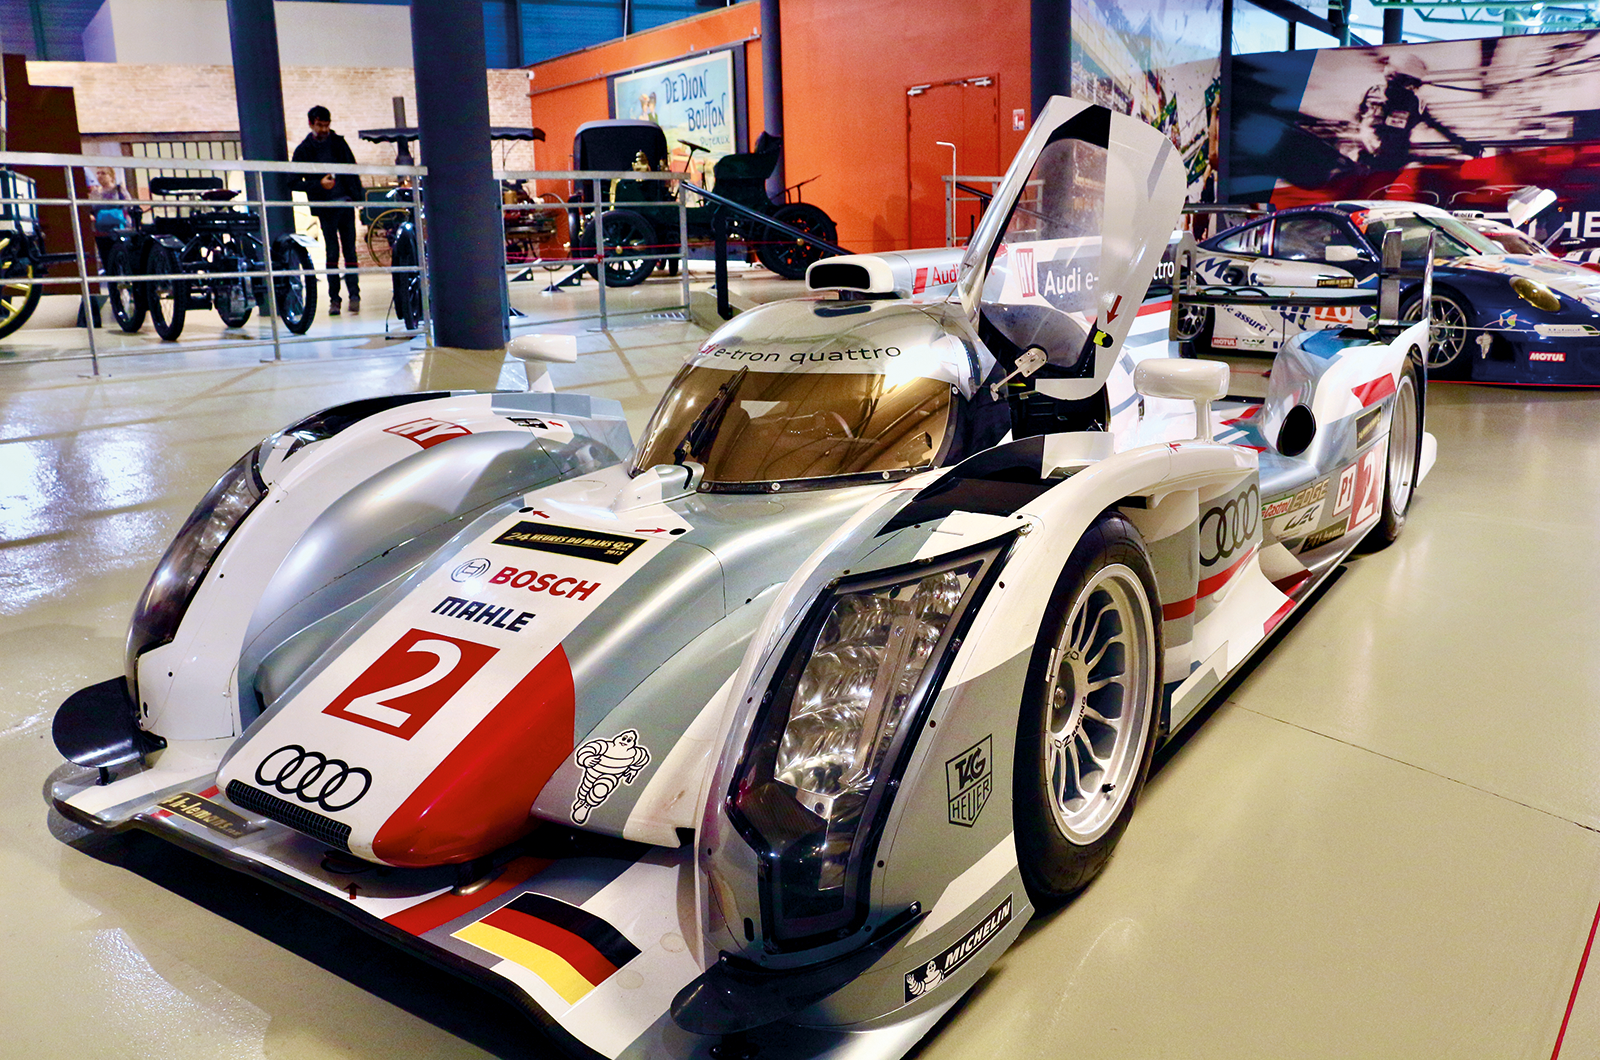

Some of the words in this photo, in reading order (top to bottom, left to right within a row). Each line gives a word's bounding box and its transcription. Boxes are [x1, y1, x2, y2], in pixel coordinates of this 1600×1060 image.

[661, 77, 679, 104] DE
[678, 69, 708, 101] DION
[685, 92, 726, 134] BOUTON
[931, 264, 959, 287] Audi
[1017, 248, 1036, 297] HY
[1044, 267, 1082, 297] Audi
[714, 347, 780, 362] e-tron
[789, 346, 901, 364] quattro
[1529, 352, 1565, 362] MOTUL
[1264, 499, 1292, 518] Castrol
[1292, 478, 1330, 507] EDGE
[1338, 472, 1354, 508] P1
[1355, 450, 1376, 525] 2
[1283, 504, 1321, 531] WEC
[504, 532, 531, 542] 24
[530, 533, 566, 543] HEURES
[565, 536, 582, 546] DU
[580, 539, 614, 549] MANS
[489, 566, 601, 601] BOSCH
[431, 596, 536, 633] MAHLE
[343, 639, 462, 728] 2
[1072, 696, 1087, 737] RACING
[955, 747, 986, 791] TAG
[952, 779, 990, 820] HEUER
[943, 901, 1011, 970] MICHELIN
